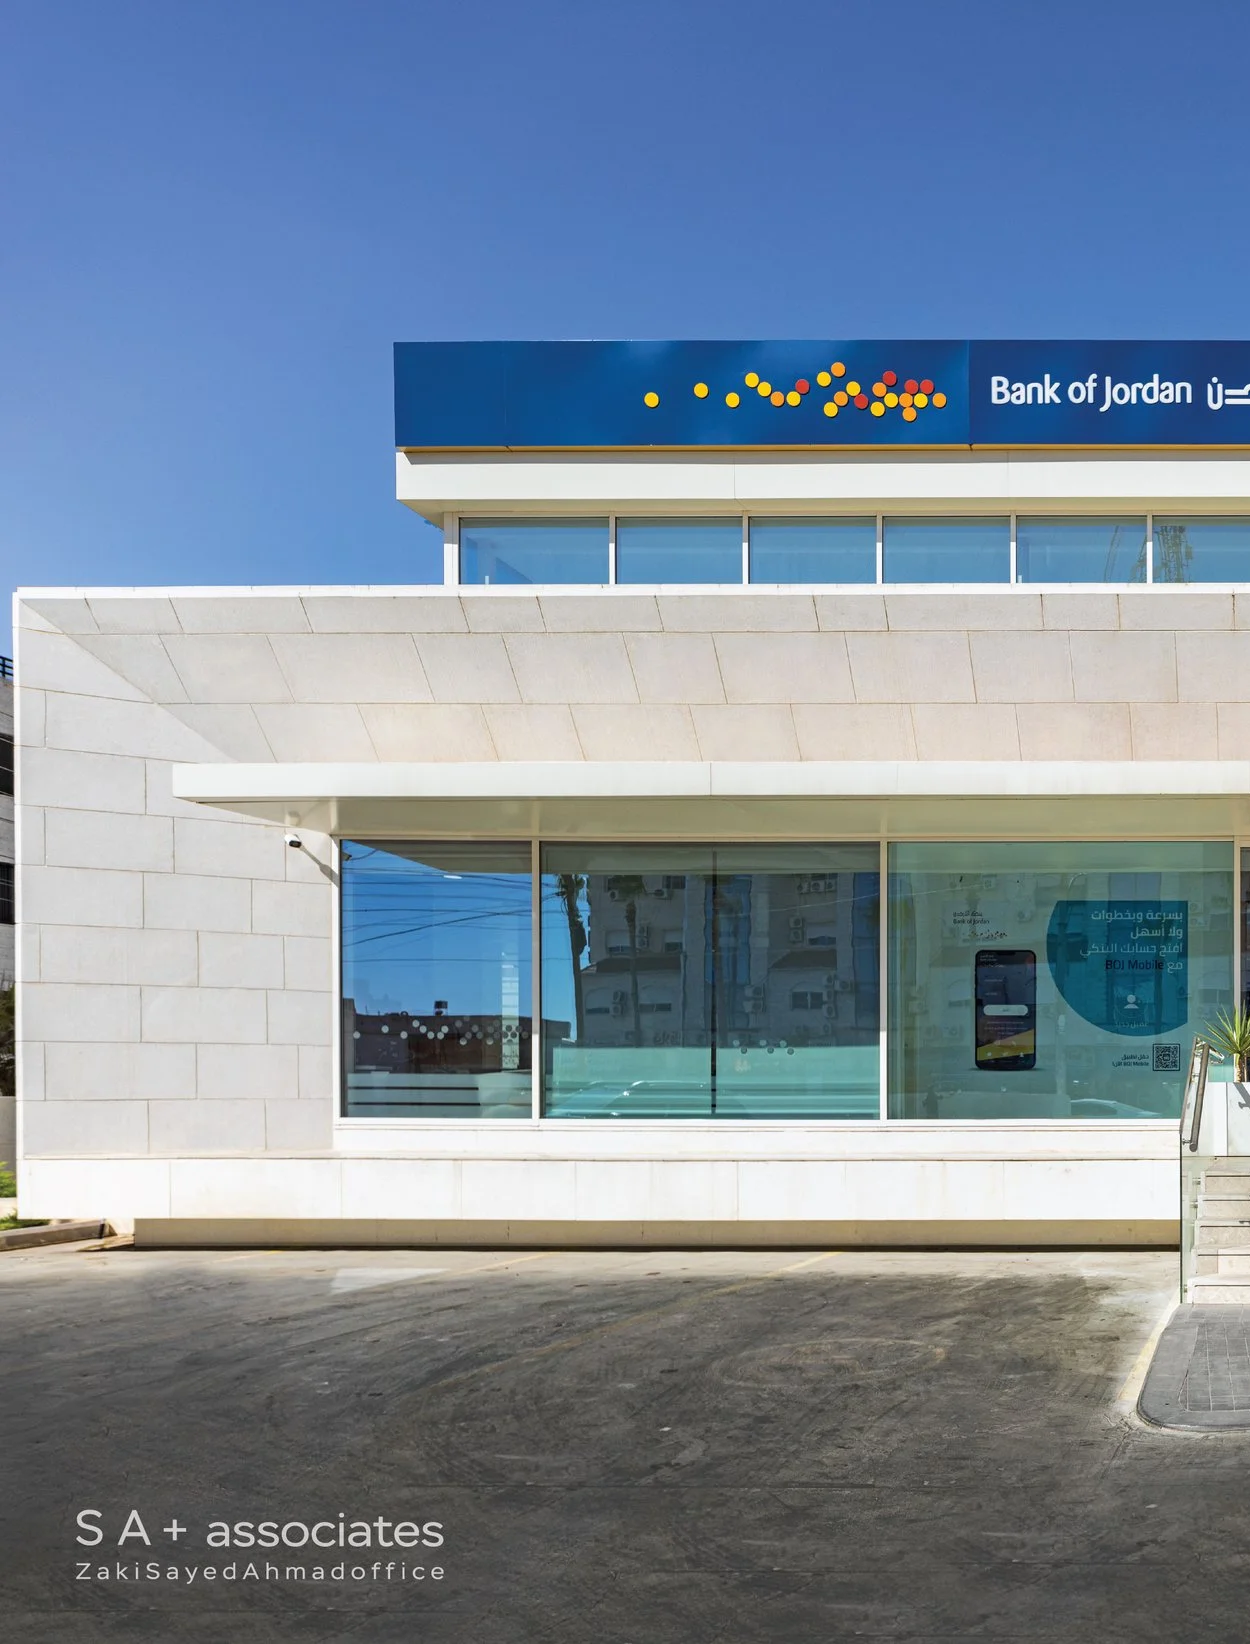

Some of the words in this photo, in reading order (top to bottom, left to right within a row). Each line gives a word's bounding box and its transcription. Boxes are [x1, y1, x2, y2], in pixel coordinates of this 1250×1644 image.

[991, 373, 1061, 405] Bank
[1067, 373, 1098, 405] of
[1099, 373, 1193, 412] Jordan
[1091, 909, 1143, 923] وبخطوات
[1146, 910, 1183, 922] بسرعة
[1168, 926, 1183, 939] ولا
[1080, 942, 1118, 958] البنكي
[1120, 942, 1157, 955] حسابك
[1159, 942, 1183, 957] افتح
[1105, 959, 1125, 970] BOJ
[1128, 959, 1164, 970] Mobile
[1167, 961, 1183, 973] مع
